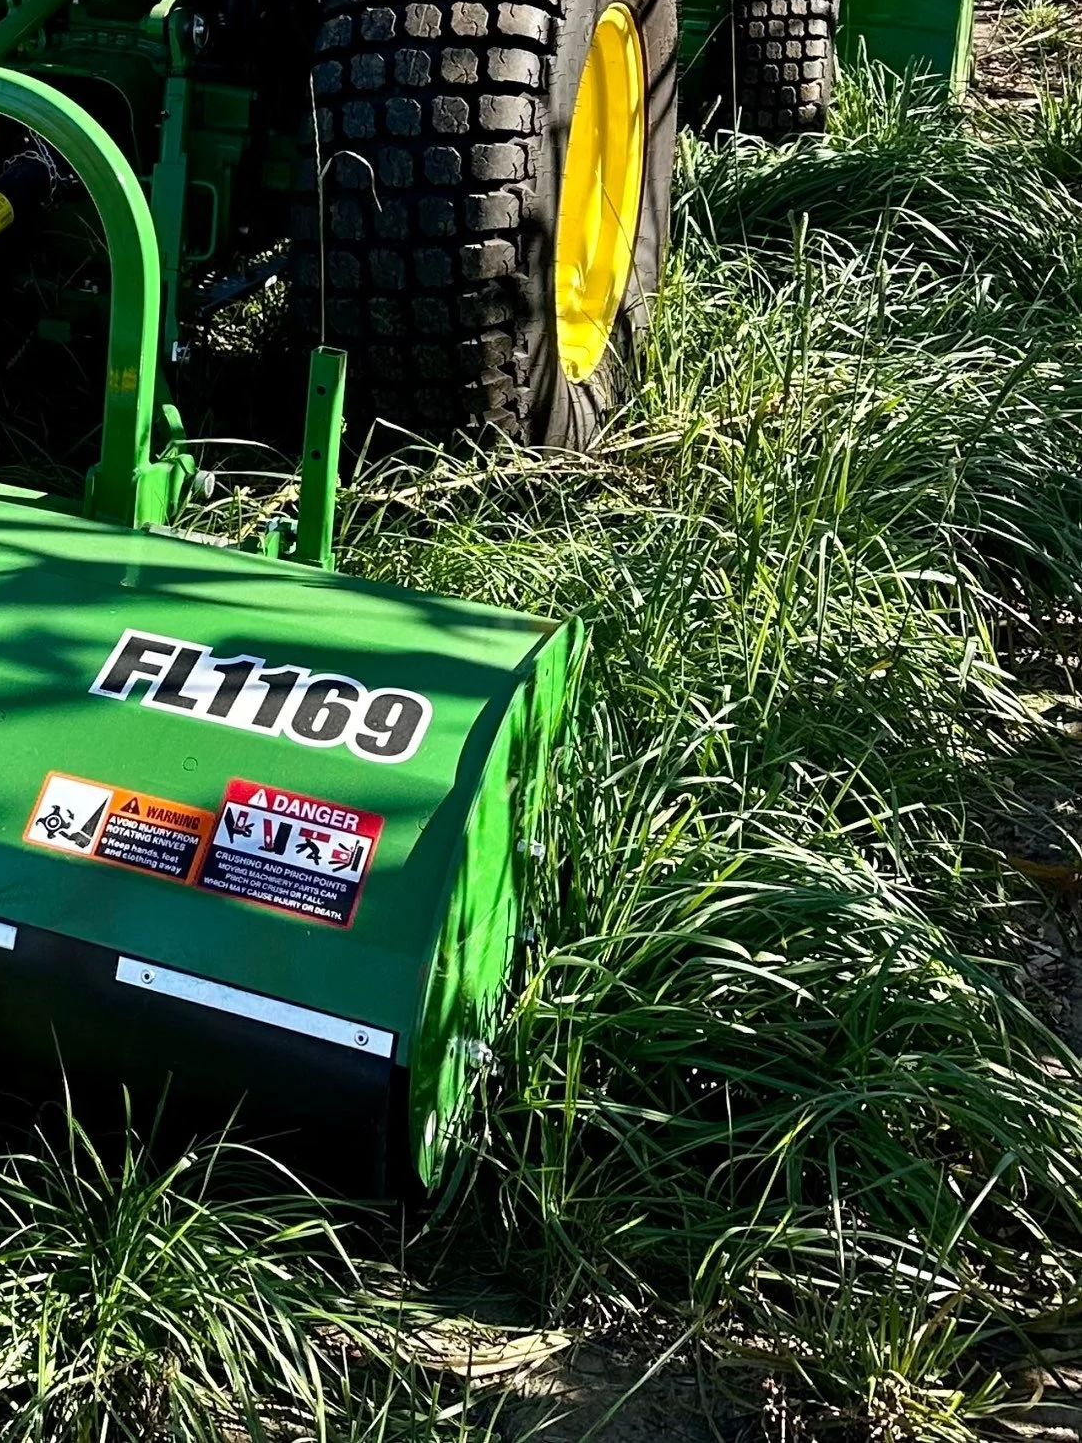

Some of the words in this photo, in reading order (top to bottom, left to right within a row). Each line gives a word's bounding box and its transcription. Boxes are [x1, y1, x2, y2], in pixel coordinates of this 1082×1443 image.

[99, 635, 425, 757] FL1169
[146, 805, 201, 830] WARNING
[272, 794, 360, 832] DANGER
[106, 824, 151, 843] ROTATING
[152, 836, 186, 851] KNIVES
[109, 815, 138, 829] AVOID
[139, 823, 172, 838] INJURY
[172, 832, 199, 845] FROM
[104, 848, 122, 858] and
[122, 851, 158, 869] clothing
[158, 861, 182, 875] away
[108, 837, 131, 851] Keep
[131, 842, 160, 859] hands,
[162, 852, 179, 863] feet
[215, 850, 262, 869] CRUSHING
[263, 863, 284, 875] AND
[283, 869, 313, 883] PINCH
[313, 876, 347, 893] POINTS
[225, 873, 249, 886] PINCH
[249, 880, 261, 889] OR
[262, 883, 290, 896] CRUSH
[290, 890, 302, 900] OR
[249, 870, 293, 888] MACHINERY
[294, 882, 320, 895] PARTS
[320, 889, 338, 900] CAN
[204, 876, 229, 889] WHICH
[229, 883, 247, 894] MAY
[247, 888, 273, 901] CAUSE
[274, 896, 302, 910] INJURY
[302, 903, 314, 912] OR
[314, 907, 343, 920] DEATH.
